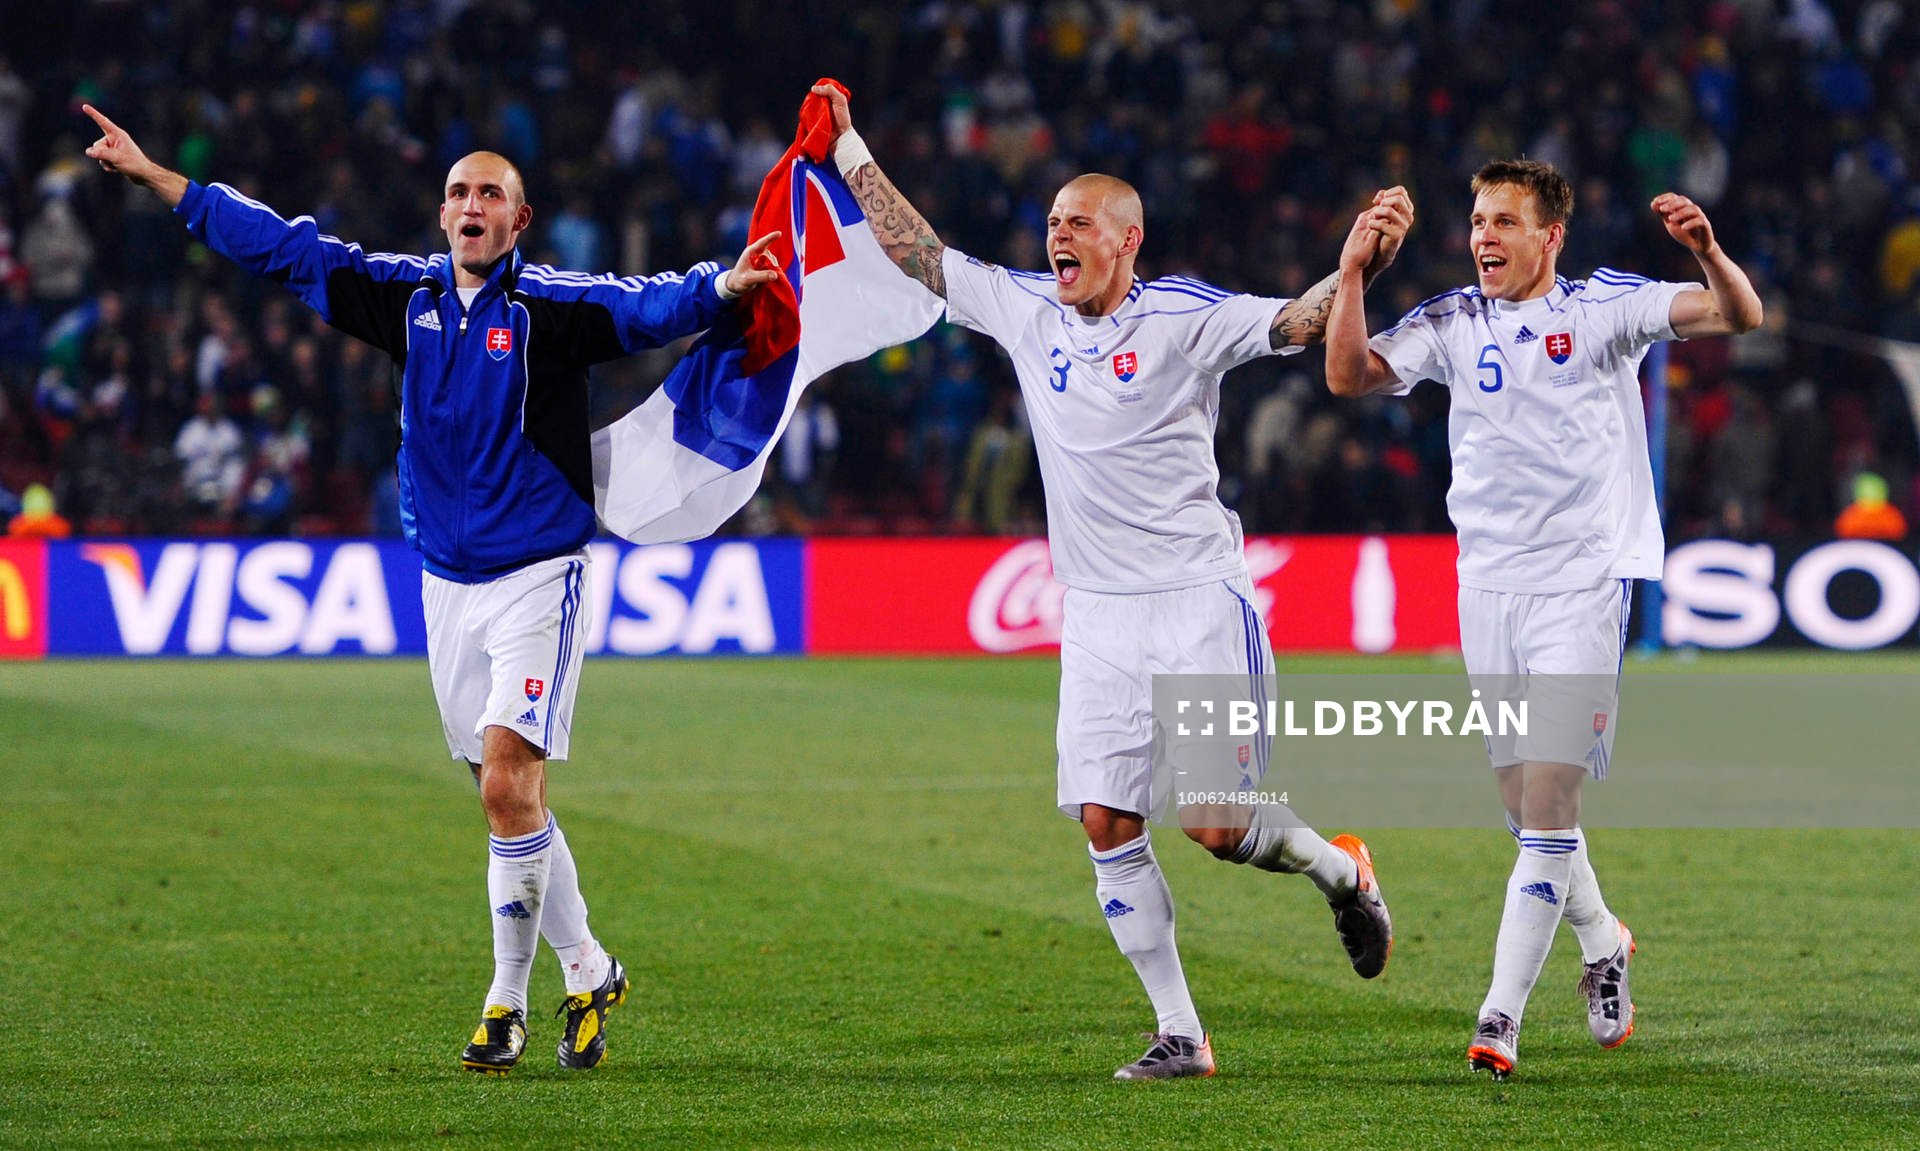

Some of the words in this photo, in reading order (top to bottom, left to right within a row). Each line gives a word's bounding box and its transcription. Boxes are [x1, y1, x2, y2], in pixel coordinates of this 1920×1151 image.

[414, 318, 442, 332] adidas
[1513, 334, 1539, 345] adidas
[1049, 347, 1072, 393] 3
[1477, 344, 1503, 393] 5
[80, 541, 398, 656] VISA
[583, 542, 776, 655] ISA
[1520, 886, 1558, 905] adidas
